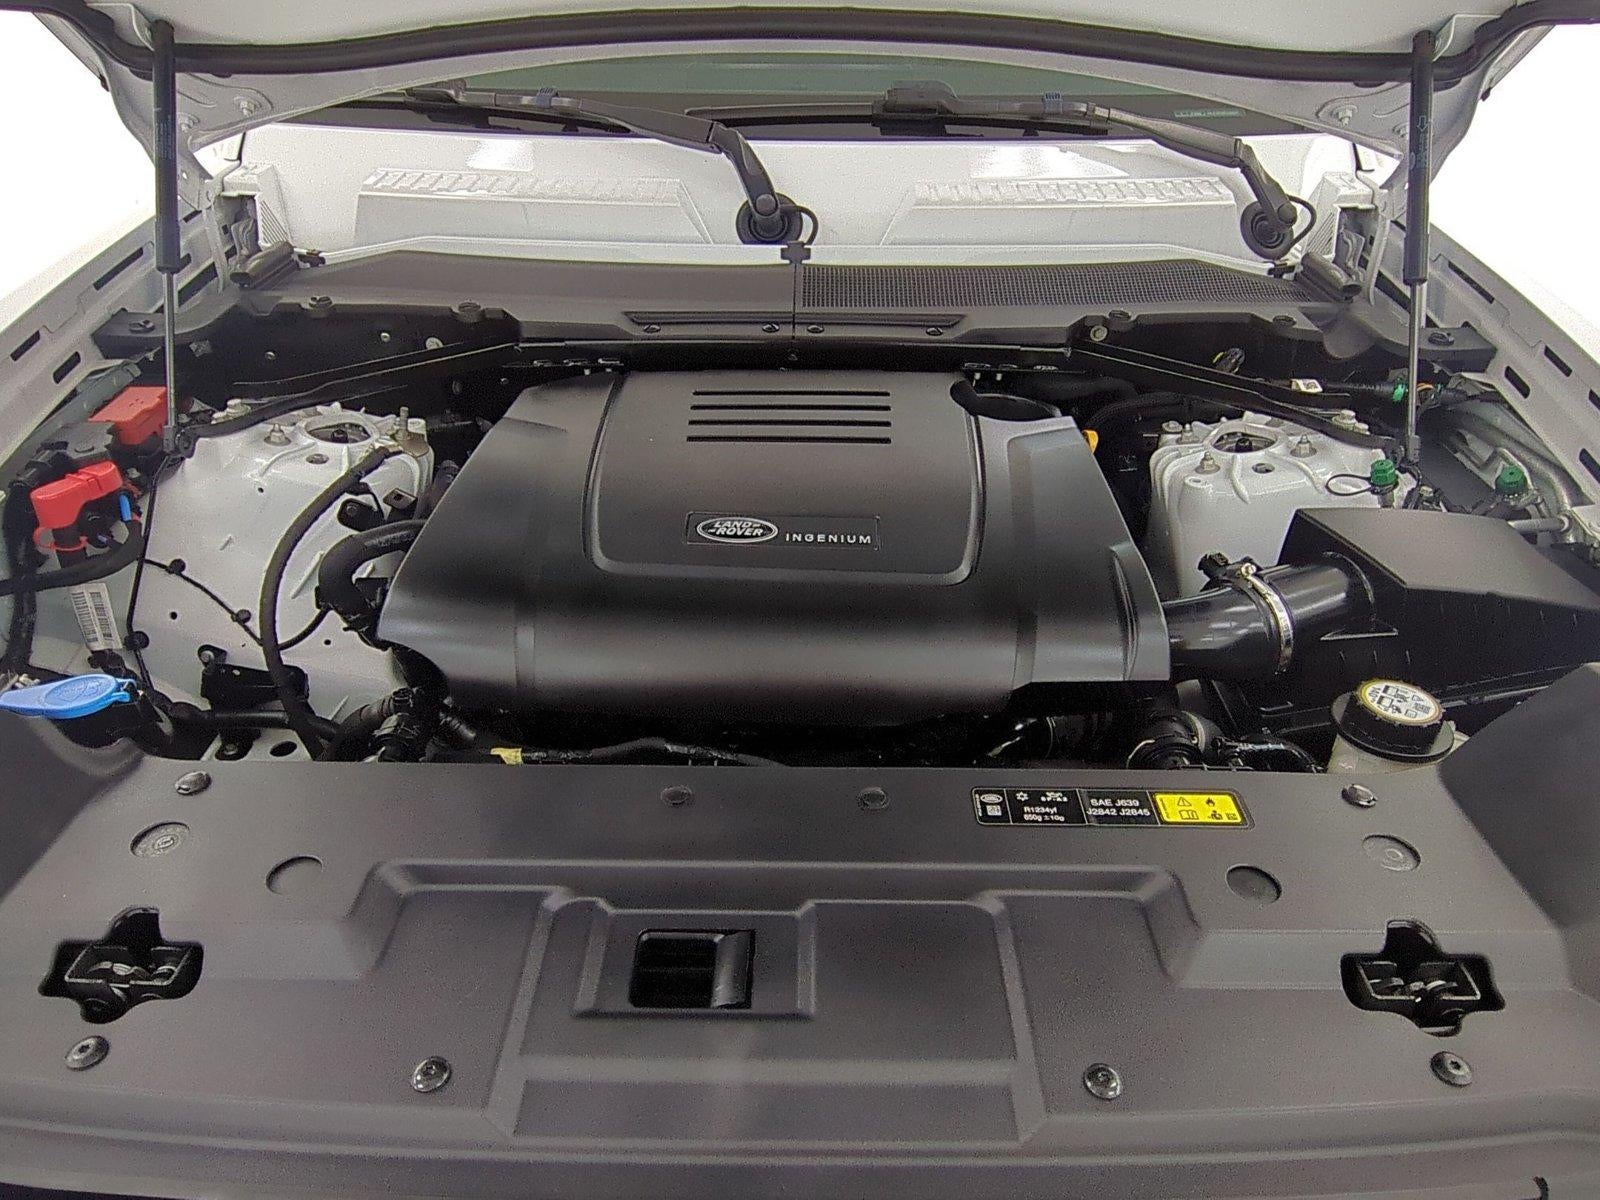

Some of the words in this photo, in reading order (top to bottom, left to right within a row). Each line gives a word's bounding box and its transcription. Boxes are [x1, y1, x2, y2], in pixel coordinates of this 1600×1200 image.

[715, 527, 764, 536] ROVER
[785, 533, 871, 544] INGENIUM
[1090, 798, 1113, 807] SAE
[1114, 798, 1140, 807] J639
[1086, 807, 1118, 816] J2842
[1119, 808, 1151, 816] J2845
